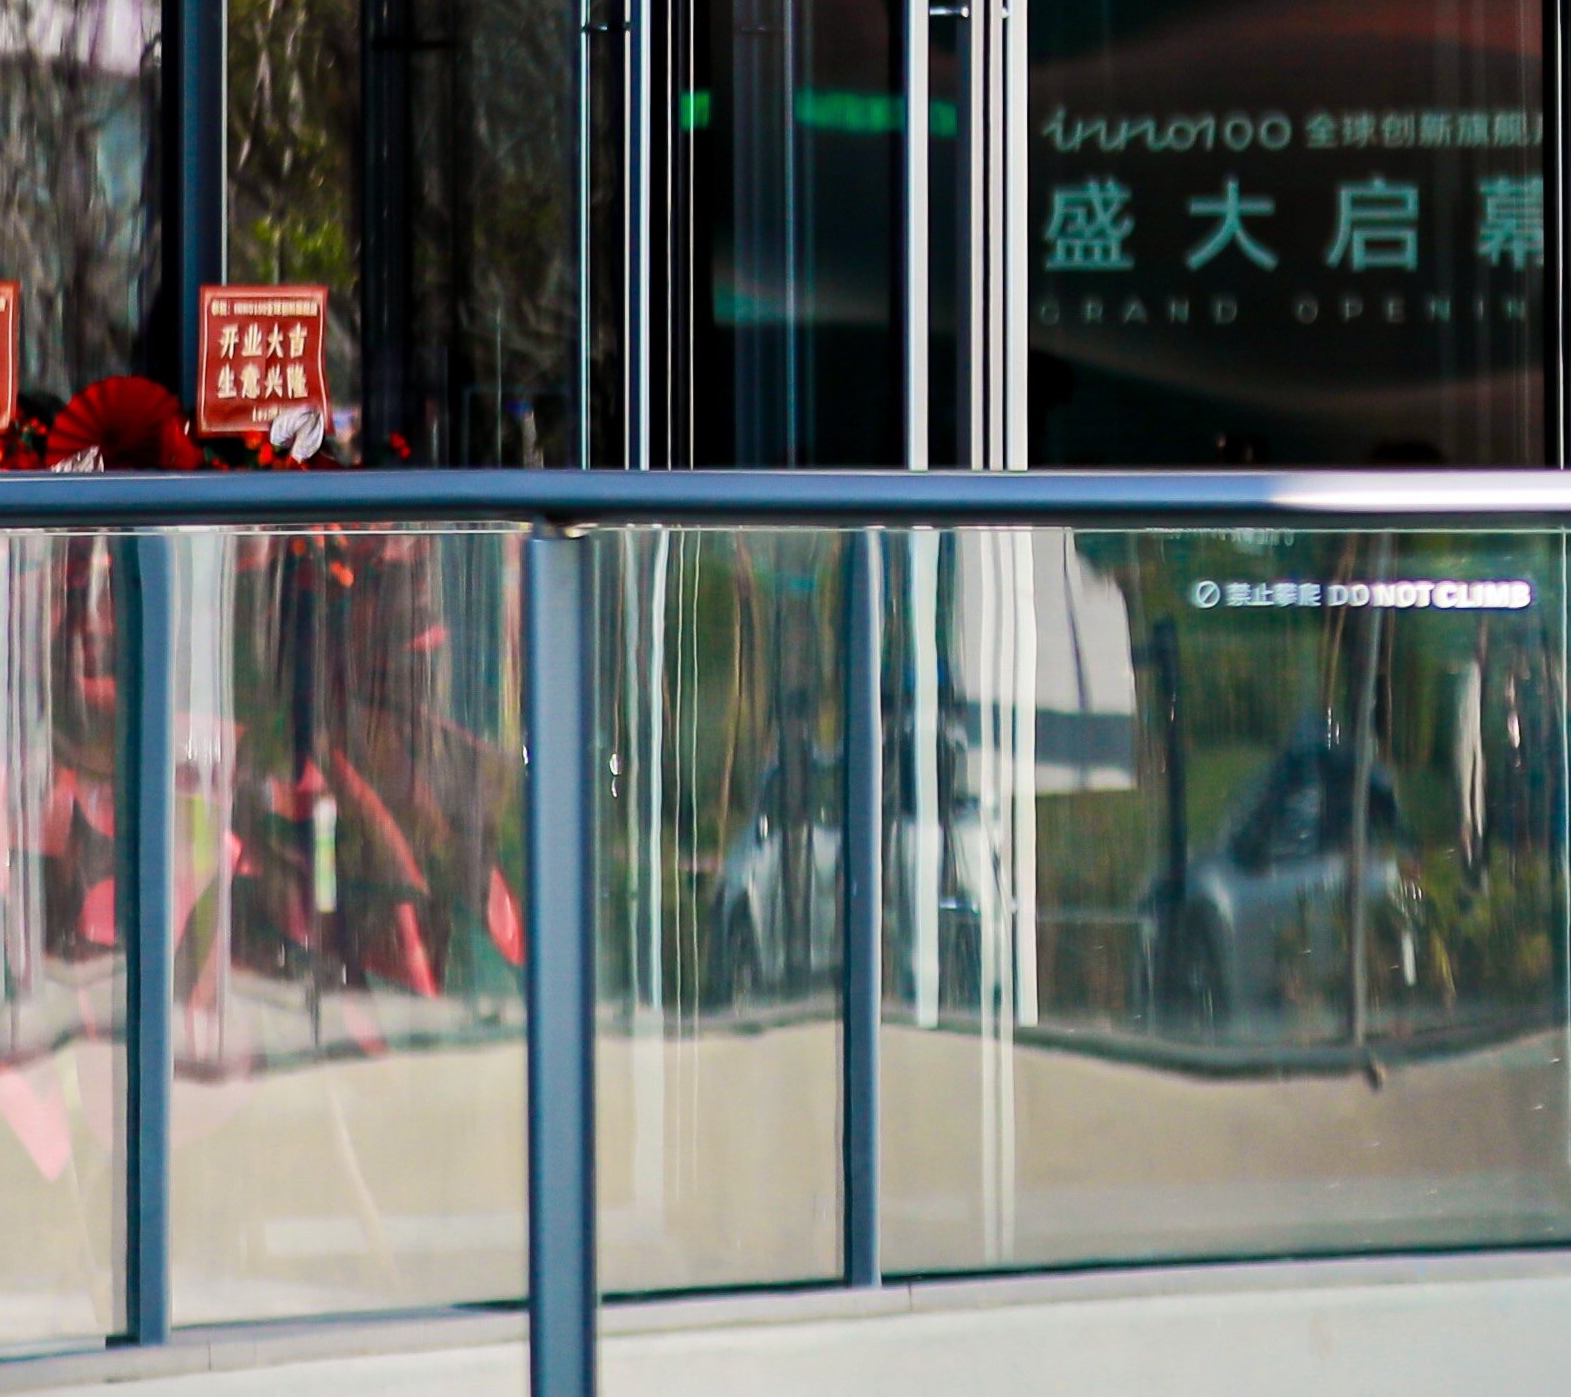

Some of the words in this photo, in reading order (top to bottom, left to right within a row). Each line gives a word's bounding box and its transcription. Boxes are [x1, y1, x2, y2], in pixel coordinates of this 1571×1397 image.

[1042, 105, 1292, 153] inno100
[1305, 110, 1543, 149] 全球创新旗舰
[219, 322, 308, 359] 开业大吉
[217, 362, 308, 399] 生意兴隆
[1328, 582, 1371, 608] DO
[1373, 581, 1433, 609] NOT
[1432, 580, 1532, 609] CLIMB
